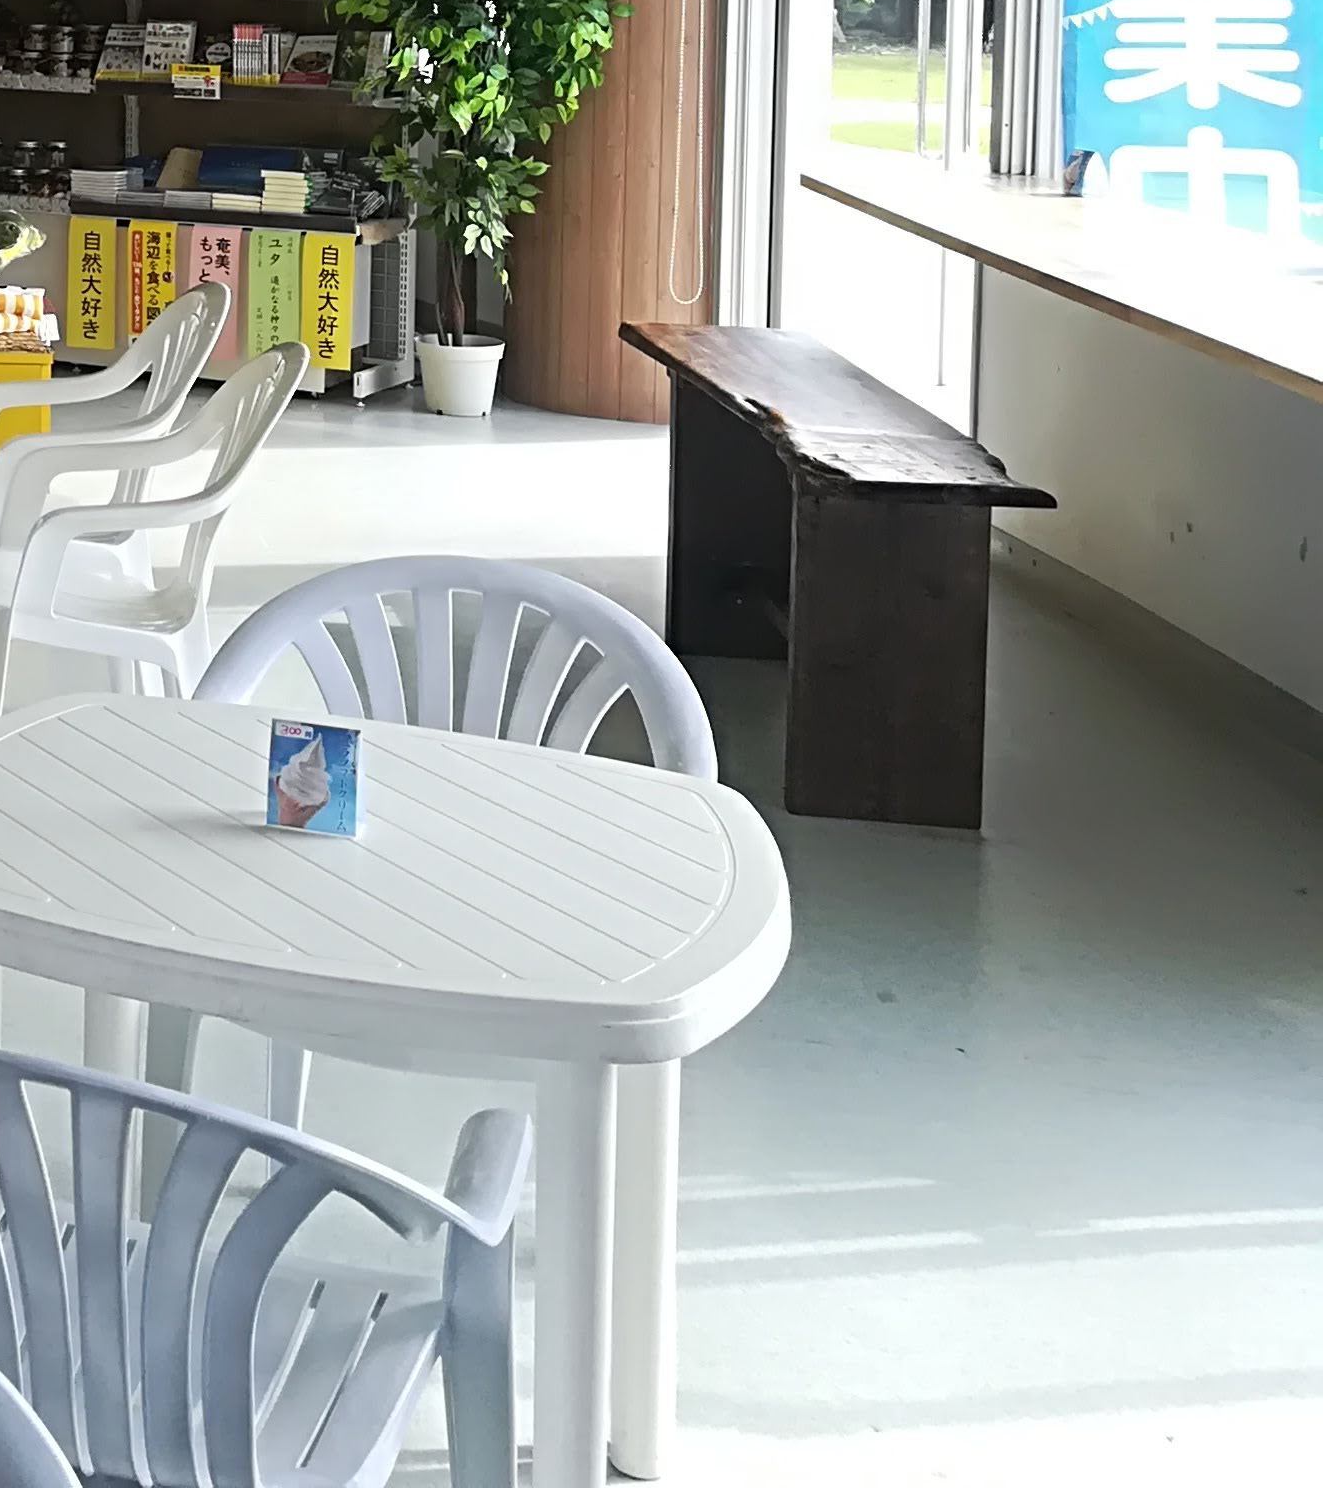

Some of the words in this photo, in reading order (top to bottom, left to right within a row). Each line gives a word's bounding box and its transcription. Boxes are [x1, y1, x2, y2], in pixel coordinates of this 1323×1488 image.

[80, 230, 103, 340] 自然大好き
[146, 231, 162, 326] 海辺を食べる図
[268, 238, 283, 266] ユタ
[316, 244, 340, 360] 自然大好き
